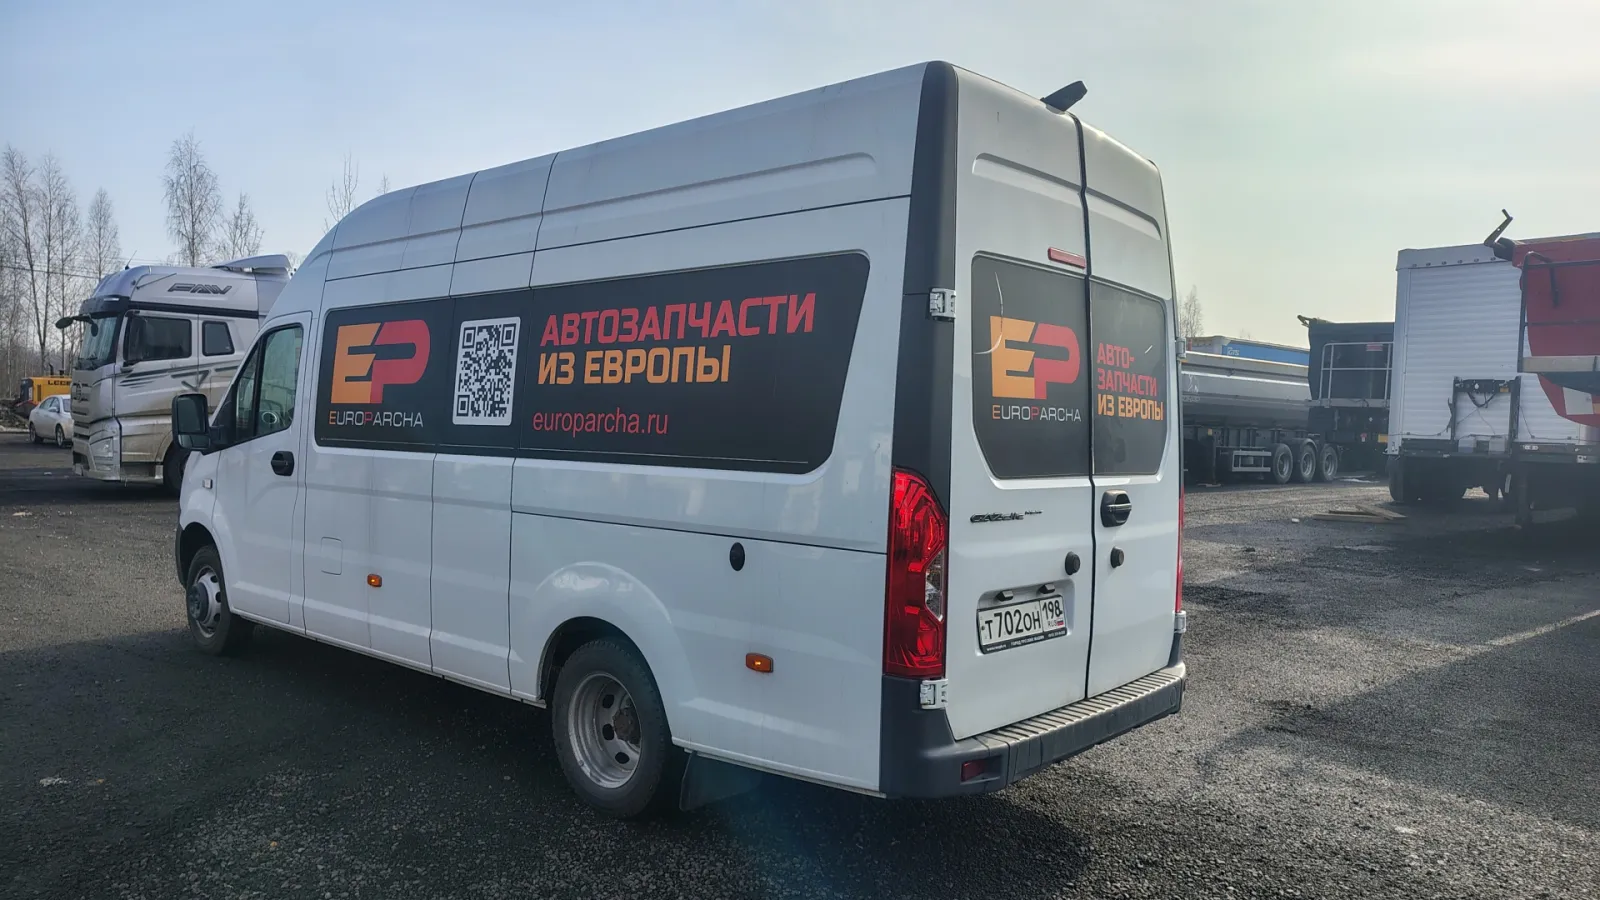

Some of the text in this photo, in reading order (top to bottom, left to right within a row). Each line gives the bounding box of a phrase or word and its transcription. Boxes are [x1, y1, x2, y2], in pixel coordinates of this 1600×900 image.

[167, 283, 232, 294] FAW
[540, 293, 817, 347] АВТОЗАПЧАСТИ
[538, 345, 732, 385] ИЗ ЕВРОПЫ
[1097, 343, 1135, 368] АВТО-
[1097, 370, 1157, 396] ЗАПЧАСТИ
[328, 409, 424, 427] EUROPARCHA
[992, 404, 1082, 422] EUROPARCHA
[1098, 394, 1164, 421] ИЗ ЕВРОПЫ
[532, 408, 669, 438] europarcha.ru
[1042, 599, 1063, 621] 198
